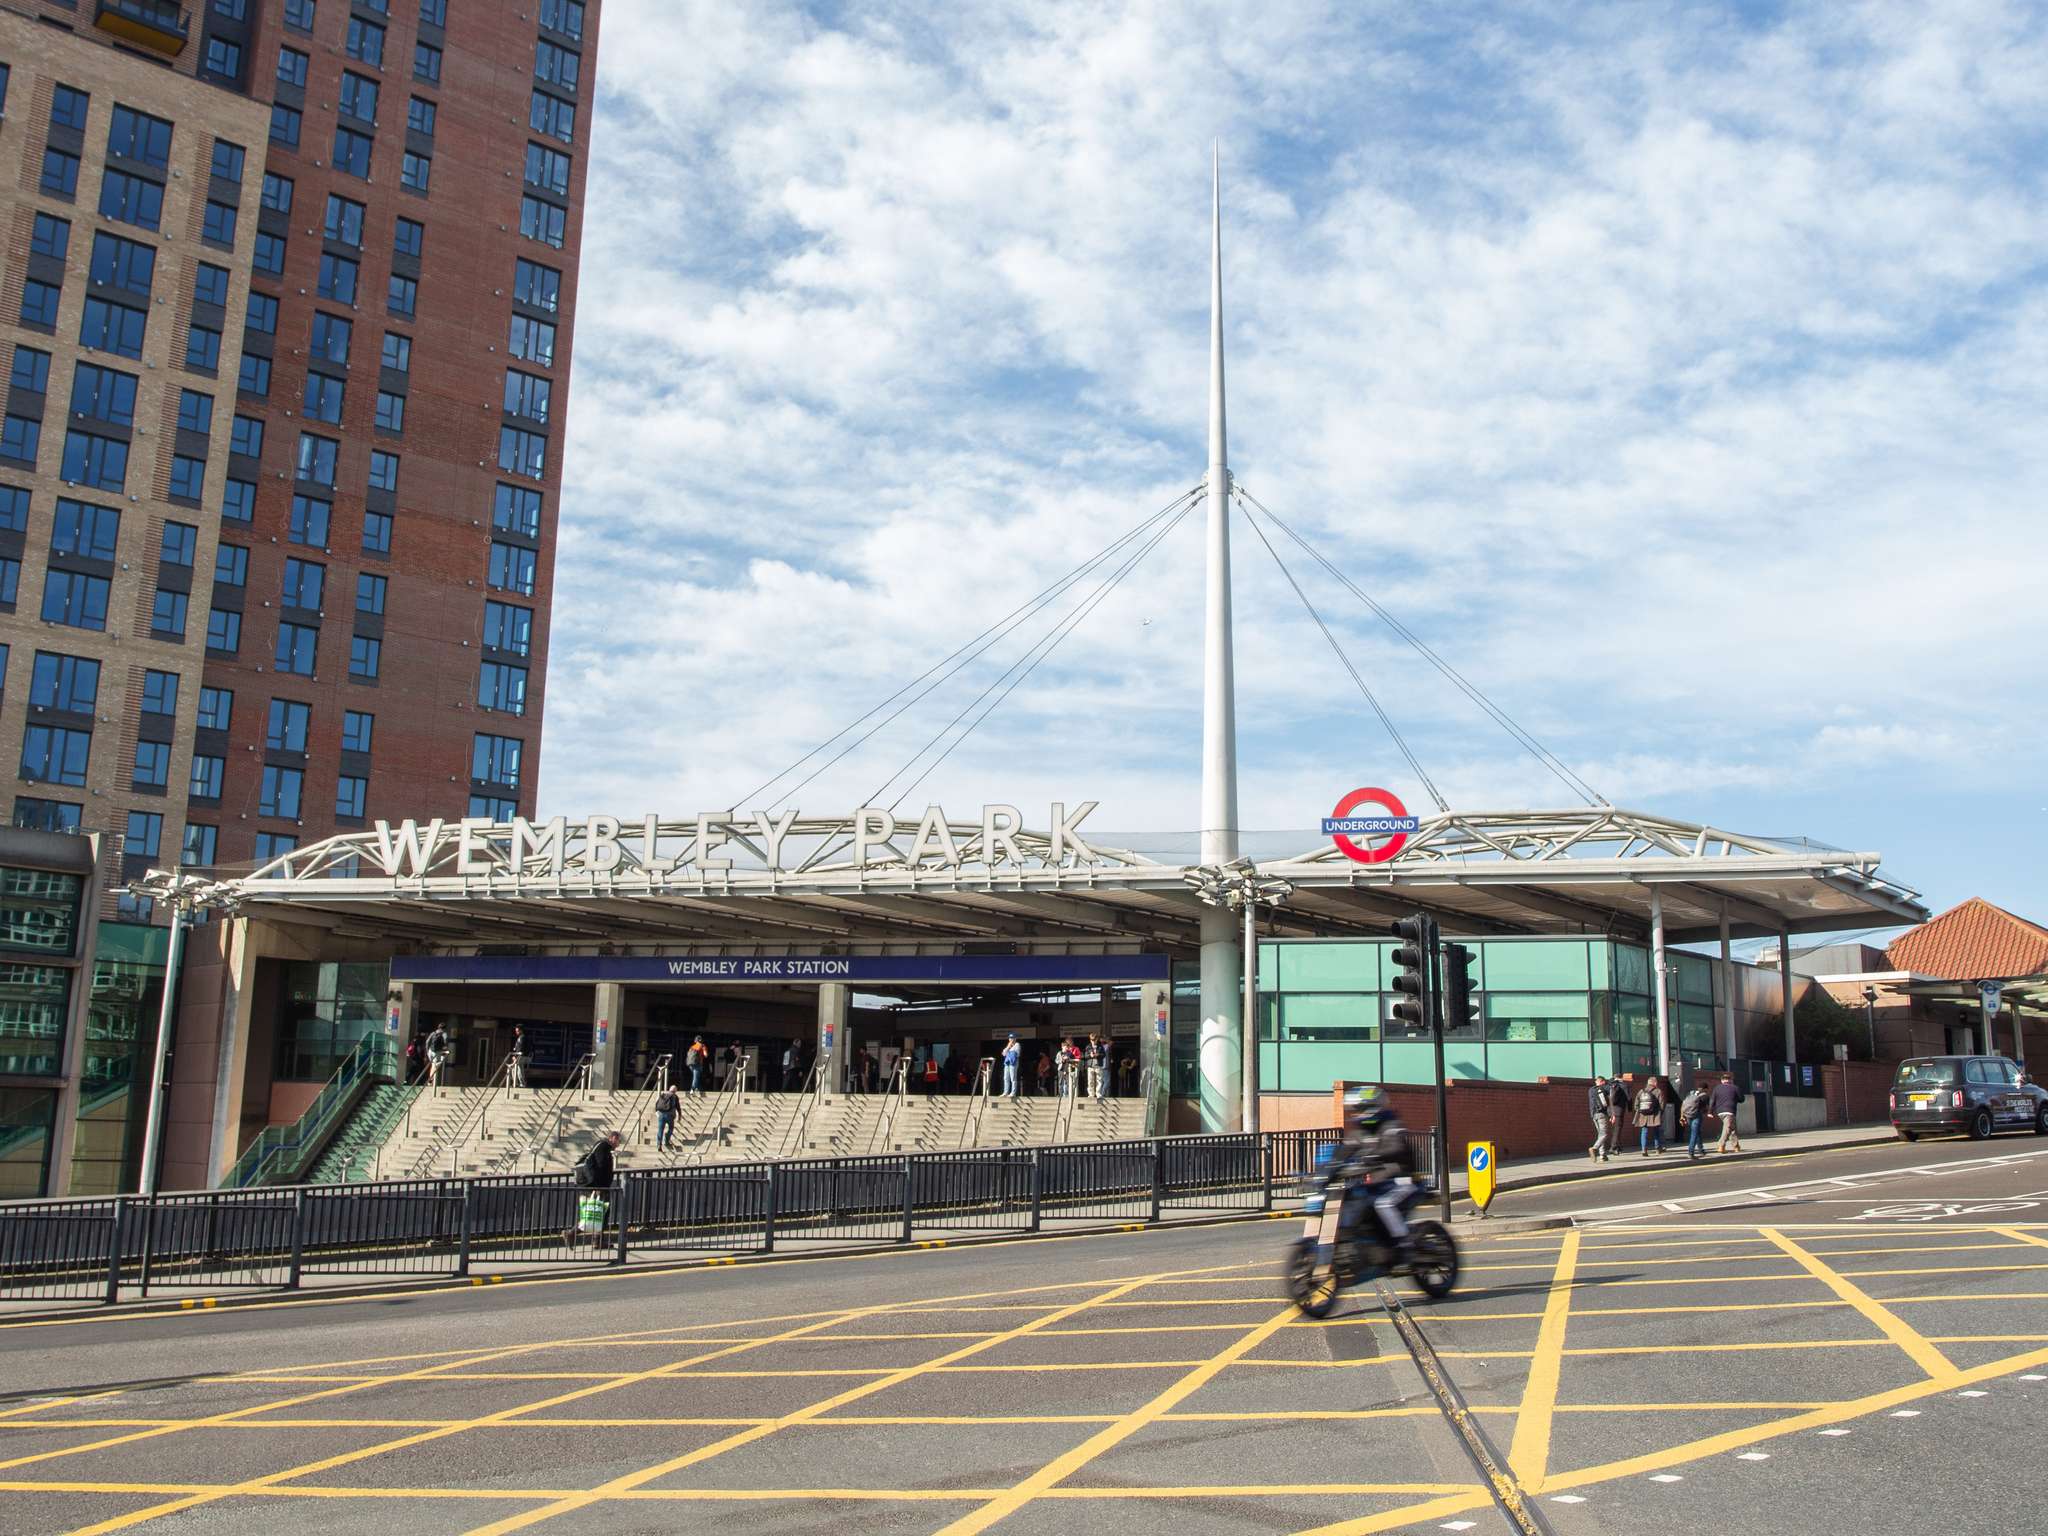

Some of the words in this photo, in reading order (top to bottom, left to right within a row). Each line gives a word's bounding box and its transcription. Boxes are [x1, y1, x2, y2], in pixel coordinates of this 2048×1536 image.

[1326, 820, 1415, 831] UNDERGROUND
[375, 809, 800, 876] WEMBLEY
[853, 801, 1100, 867] PARK
[668, 961, 738, 974] WEMBLEY
[744, 961, 782, 974] PARK
[787, 960, 849, 974] STATION
